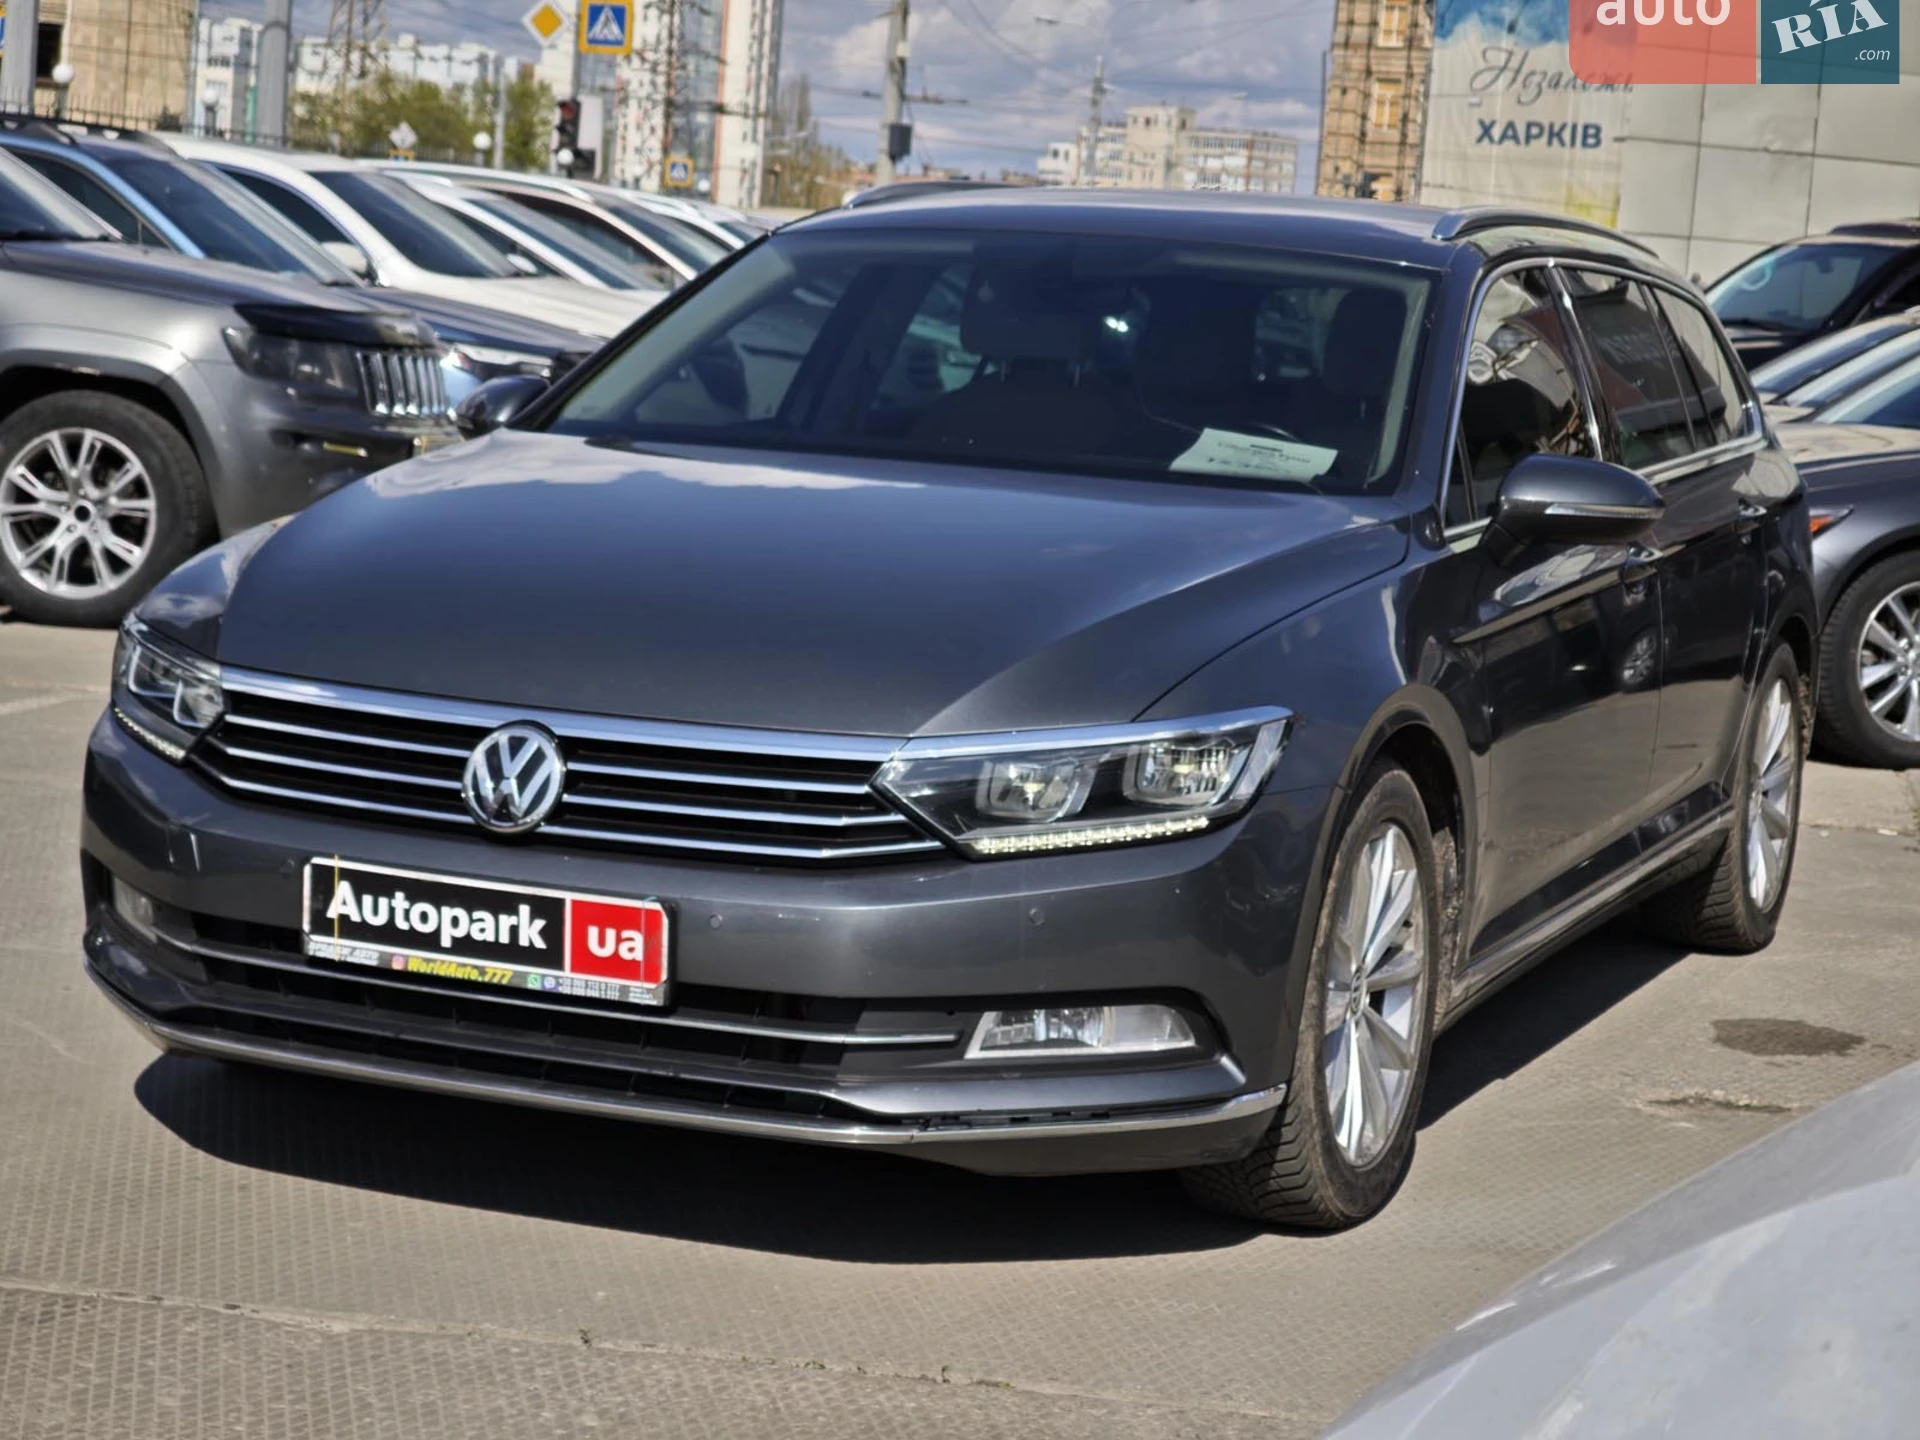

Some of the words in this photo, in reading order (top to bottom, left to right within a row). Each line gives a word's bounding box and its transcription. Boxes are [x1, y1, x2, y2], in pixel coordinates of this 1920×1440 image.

[1475, 117, 1603, 150] ХАРКІВ
[464, 727, 562, 831] VW
[326, 880, 548, 950] Autopark
[586, 924, 645, 962] ua
